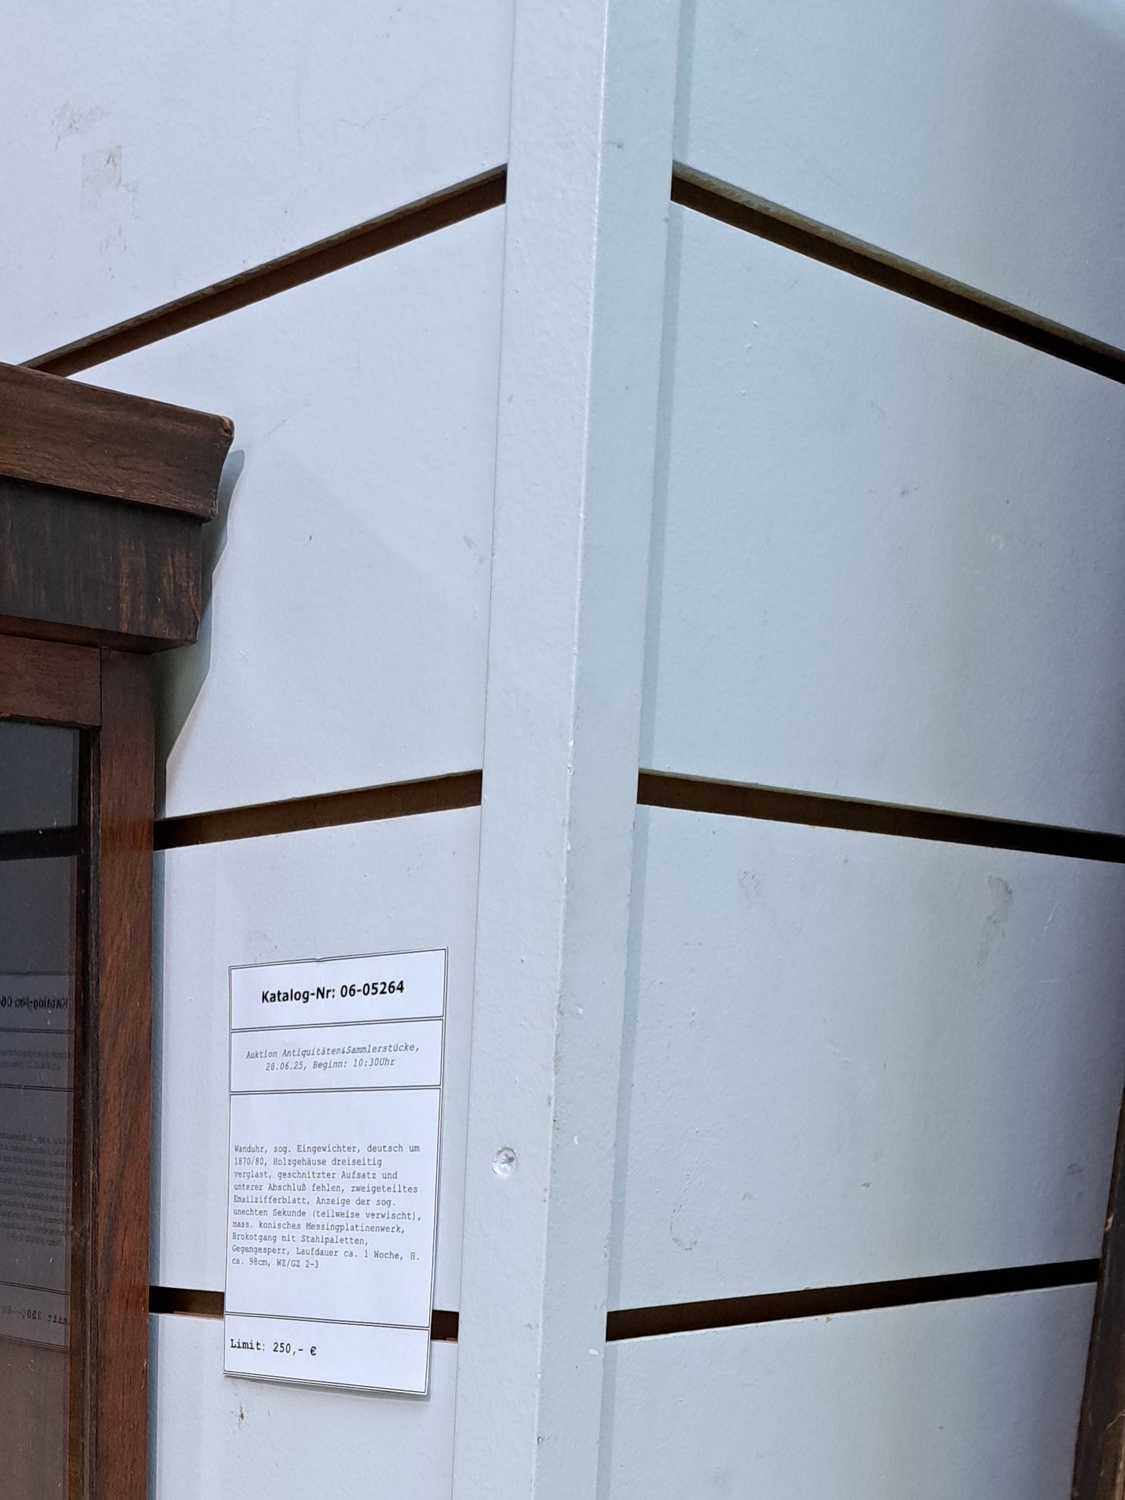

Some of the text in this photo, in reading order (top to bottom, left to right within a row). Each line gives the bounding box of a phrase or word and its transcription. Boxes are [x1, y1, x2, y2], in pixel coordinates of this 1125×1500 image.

[262, 980, 405, 1003] Katalog-Nr: 06-05264
[246, 1050, 278, 1059] Auktion
[313, 1060, 347, 1071] Beginn:
[353, 1058, 395, 1067] 10:30Uhr
[234, 1145, 268, 1154] Wanduhr,
[274, 1146, 291, 1154] sog.
[297, 1145, 361, 1154] Eingewichter,
[367, 1144, 403, 1152] deutsch
[235, 1157, 382, 1167] 1870/80, Holzgehäuse dreiseitig
[234, 1170, 397, 1179] verglast, geschnitzter Aufsatz und
[268, 1183, 306, 1191] Abschluß
[312, 1183, 344, 1193] fehlen,
[351, 1184, 418, 1194] zweigeteiltes
[234, 1195, 310, 1205] Emailzifferblatt,
[316, 1197, 350, 1207] Anzeige
[376, 1199, 396, 1208] sog.
[234, 1208, 421, 1221] unechten Sekunde (teilweise verwischt),
[259, 1221, 301, 1230] konisches
[306, 1222, 405, 1233] Messingplatinenwerk,
[233, 1232, 277, 1242] Brokotgang
[301, 1235, 368, 1245] Stahlpaletten,
[232, 1245, 290, 1255] Gegengesperr,
[296, 1247, 338, 1256] Laufdauer
[364, 1250, 368, 1258] 1
[374, 1251, 403, 1261] Woche,
[306, 1260, 319, 1268] 2-3
[230, 1339, 317, 1356] Limit: 250,- €
